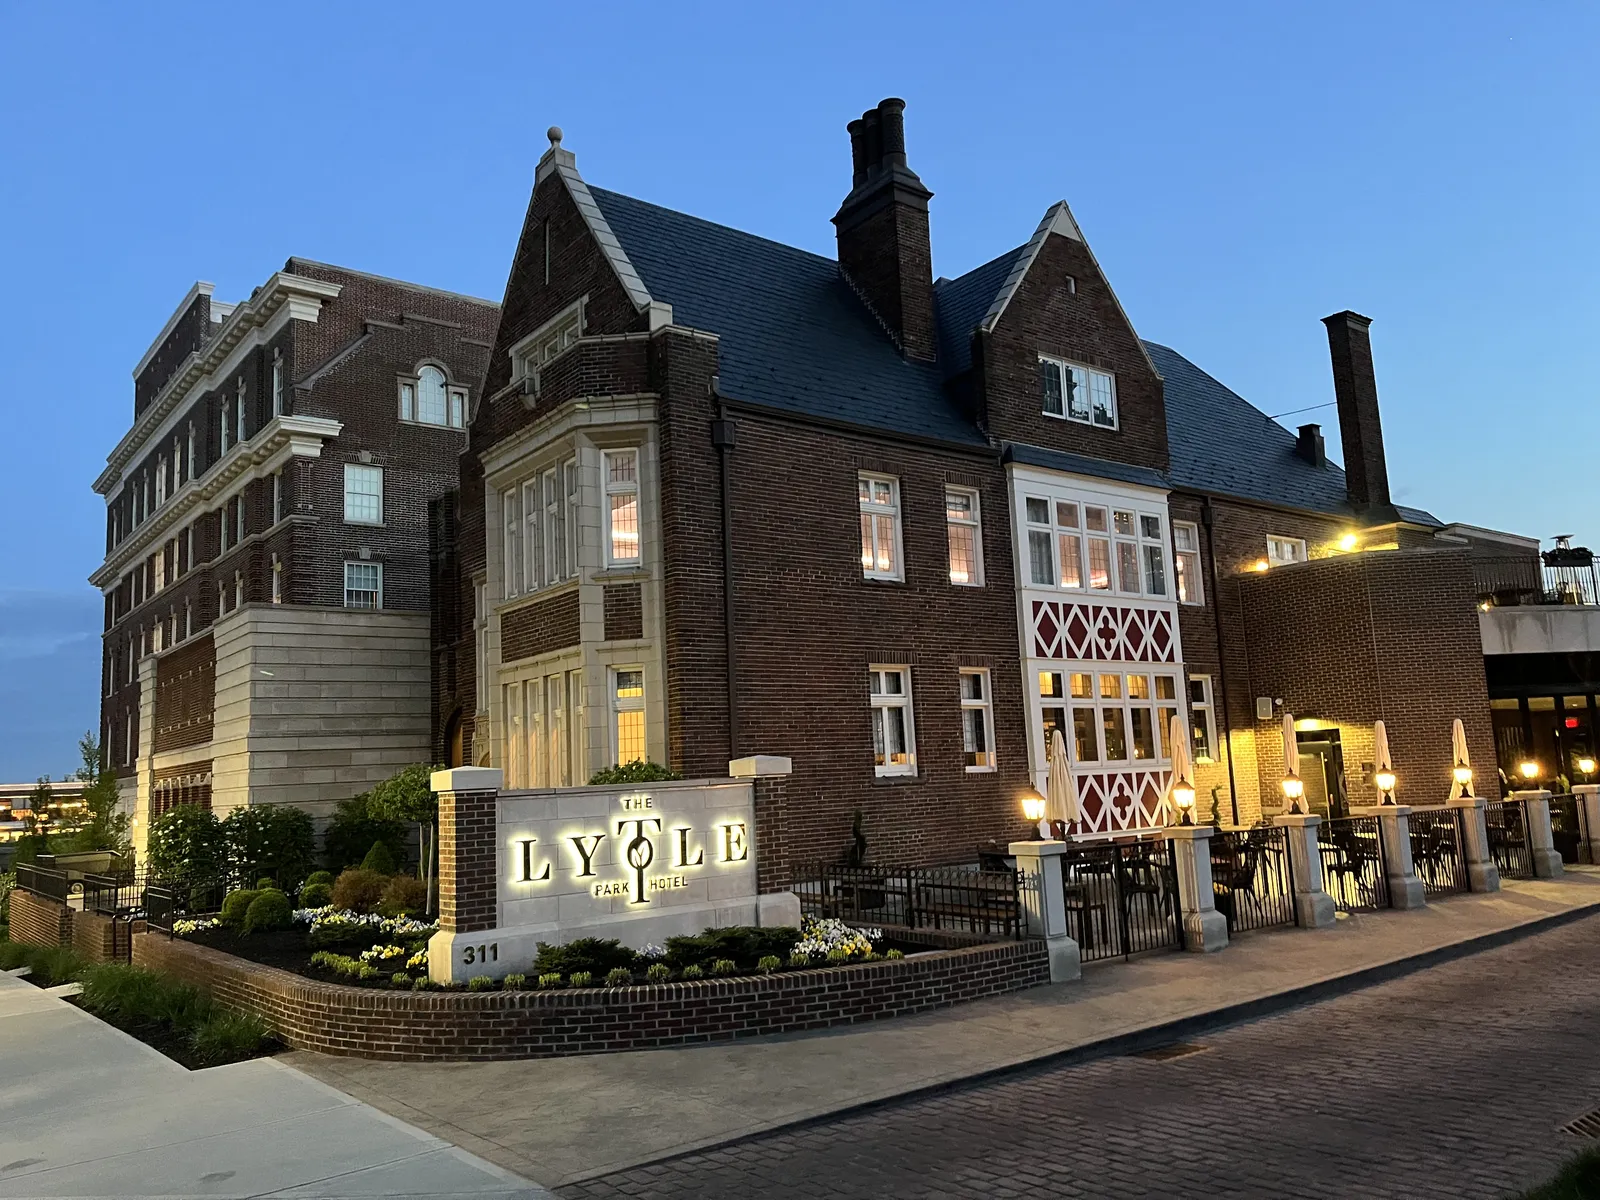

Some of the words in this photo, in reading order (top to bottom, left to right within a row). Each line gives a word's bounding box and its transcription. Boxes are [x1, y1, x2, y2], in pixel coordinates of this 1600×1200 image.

[624, 797, 653, 810] THE
[515, 819, 748, 904] LYTLE
[595, 882, 629, 896] PARK
[649, 876, 688, 892] HOTEL
[463, 942, 498, 965] 311
